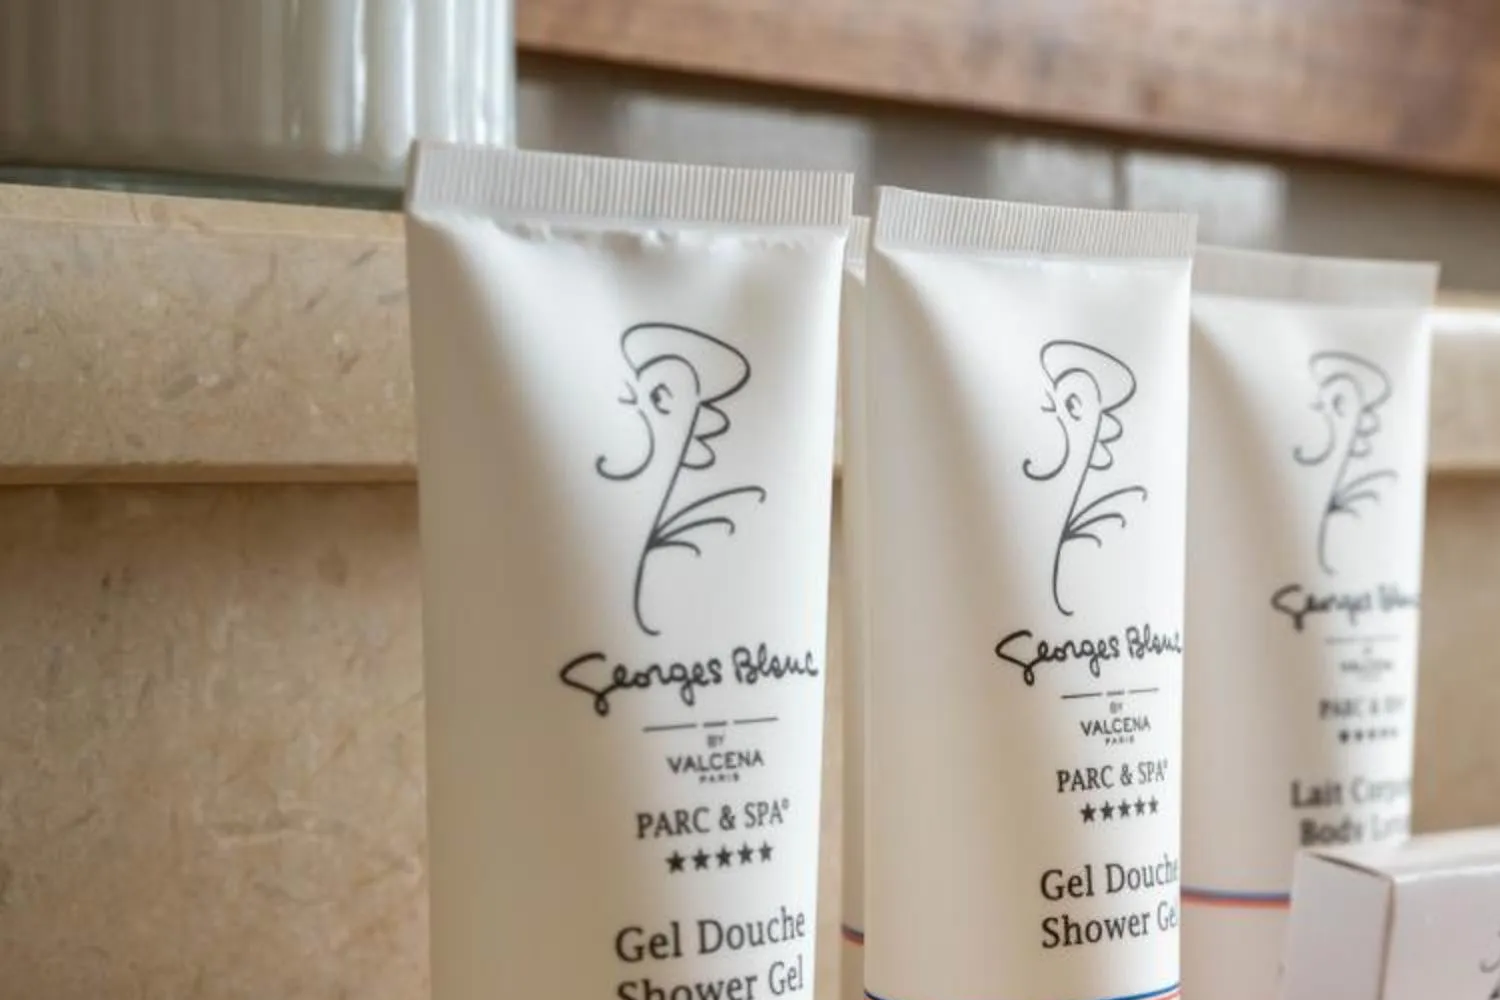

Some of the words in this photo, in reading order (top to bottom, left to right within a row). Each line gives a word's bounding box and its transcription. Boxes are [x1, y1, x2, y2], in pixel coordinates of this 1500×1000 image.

[995, 630, 1120, 687] Georges
[559, 652, 723, 717] Georges
[732, 643, 819, 685] Blanc
[707, 734, 725, 749] BY
[1080, 715, 1152, 737] VALCENA
[666, 750, 766, 775] VALCENA
[699, 772, 741, 784] PARIS
[1056, 765, 1114, 793] PARC
[1120, 762, 1134, 787] &
[636, 806, 711, 839] PARC
[719, 804, 737, 831] &
[1040, 863, 1095, 901] Gel
[615, 920, 684, 963] Gel
[697, 905, 806, 955] Douche
[1041, 912, 1151, 949] Shower
[768, 953, 804, 996] Gel
